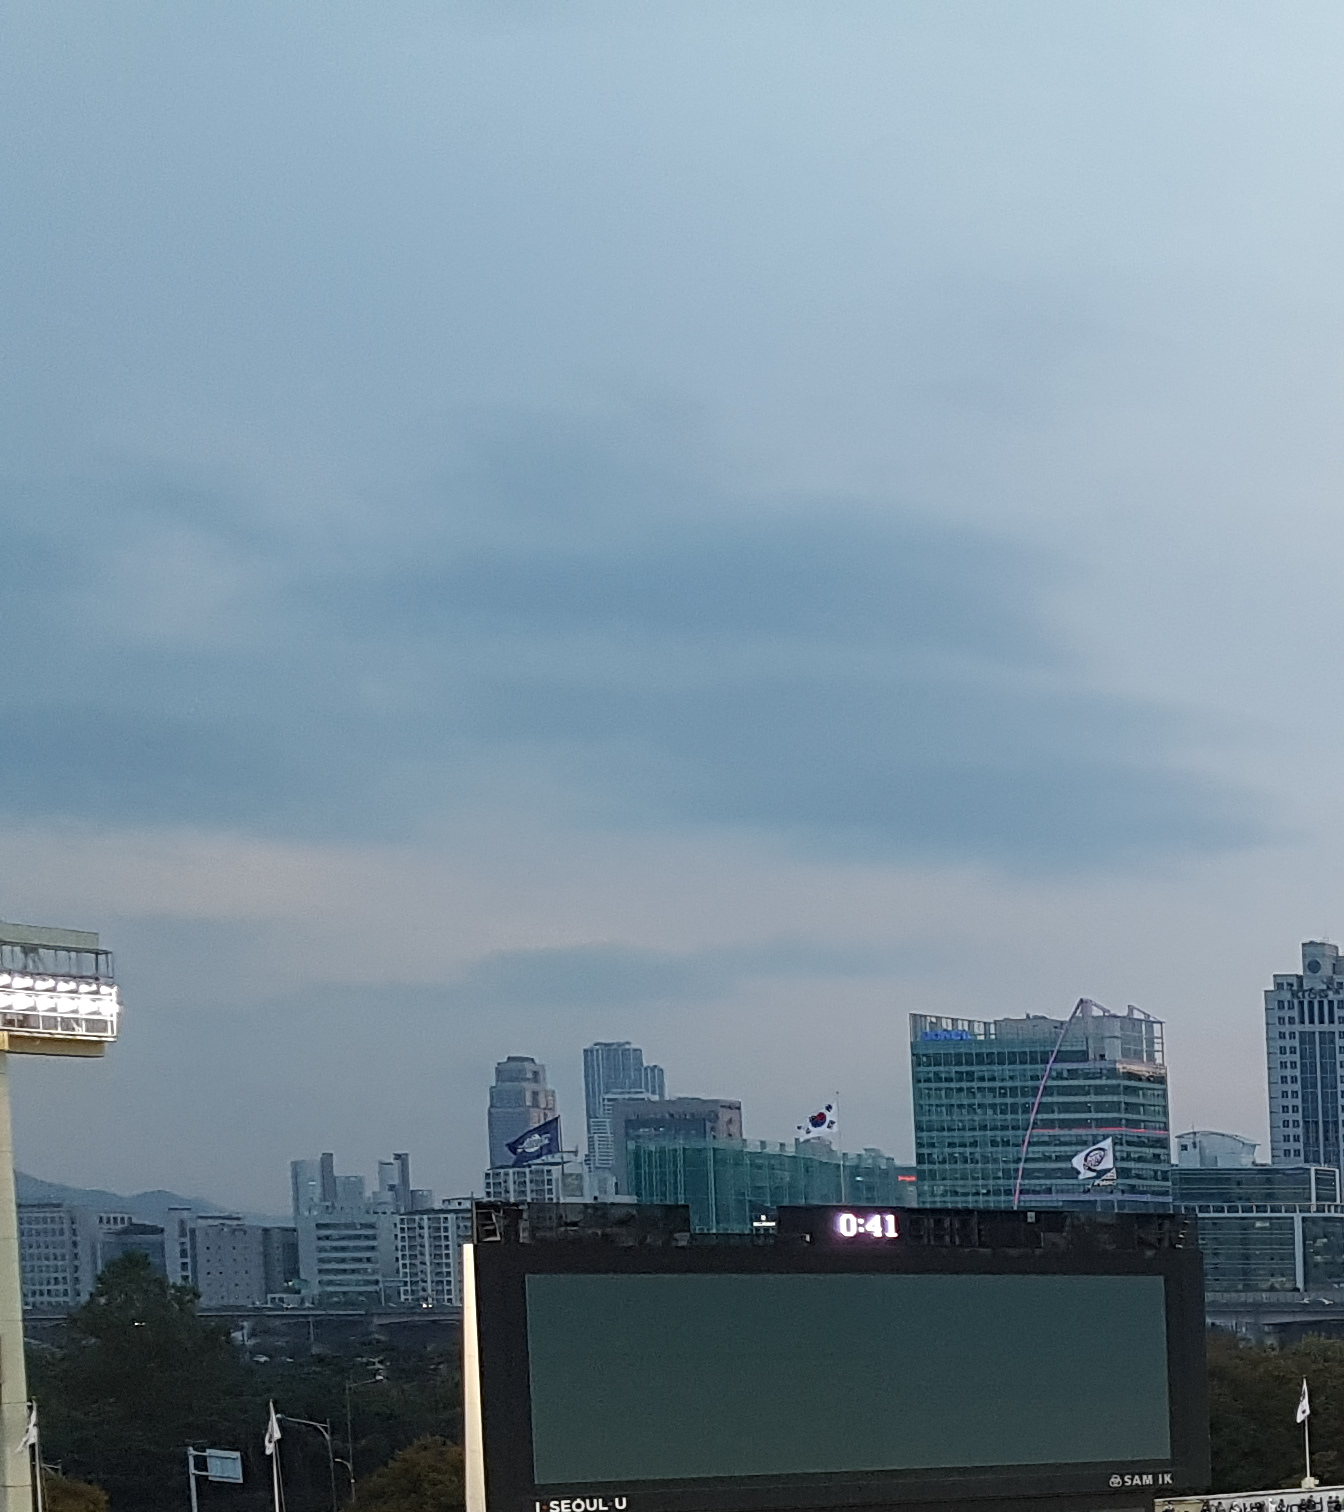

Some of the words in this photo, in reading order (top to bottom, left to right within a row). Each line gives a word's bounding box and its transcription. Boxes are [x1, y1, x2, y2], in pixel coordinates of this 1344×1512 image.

[839, 1212, 899, 1238] 0:41
[1123, 1474, 1154, 1487] SAM
[1158, 1473, 1173, 1485] IK
